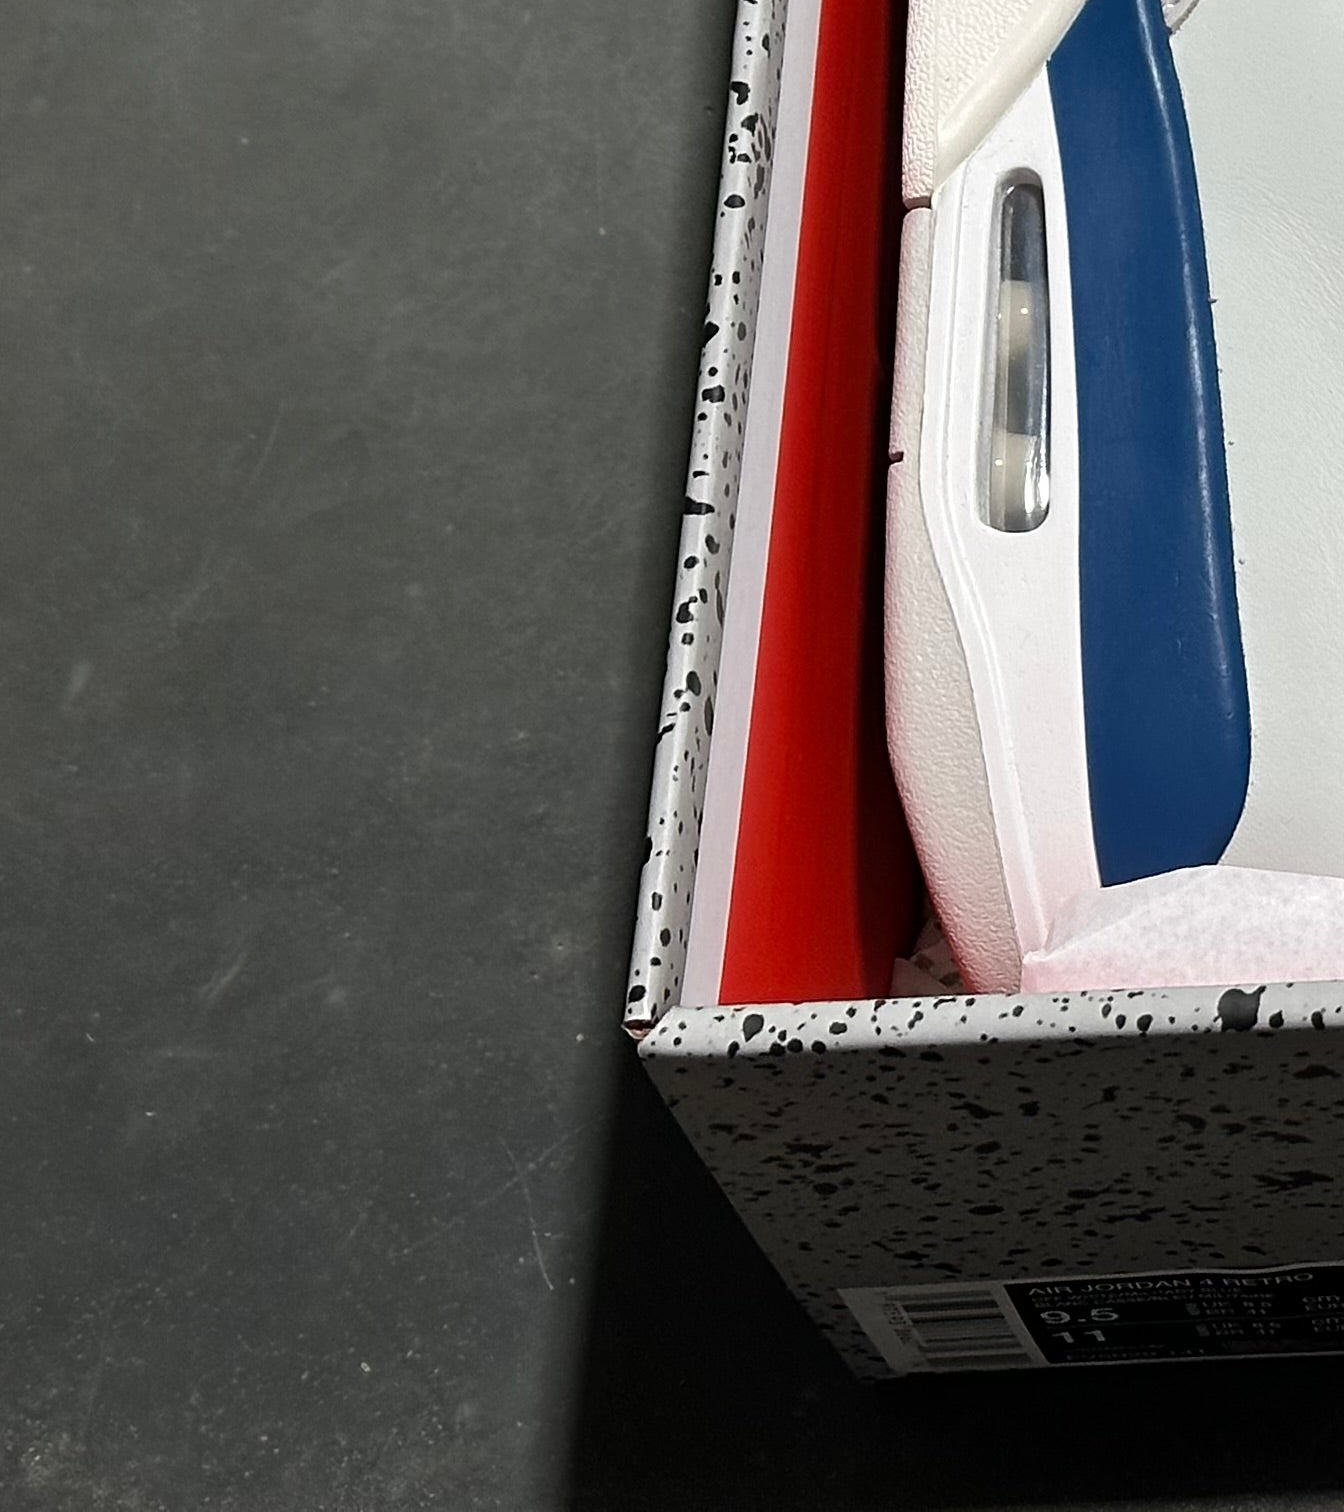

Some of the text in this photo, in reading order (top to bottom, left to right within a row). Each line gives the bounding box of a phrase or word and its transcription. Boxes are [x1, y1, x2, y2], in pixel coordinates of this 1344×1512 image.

[1029, 1285, 1073, 1296] AIR
[1080, 1279, 1191, 1293] JORDAN
[1199, 1278, 1213, 1286] 4
[1222, 1272, 1314, 1286] RETRO
[1040, 1307, 1120, 1325] 9.5
[1051, 1329, 1106, 1343] 11
